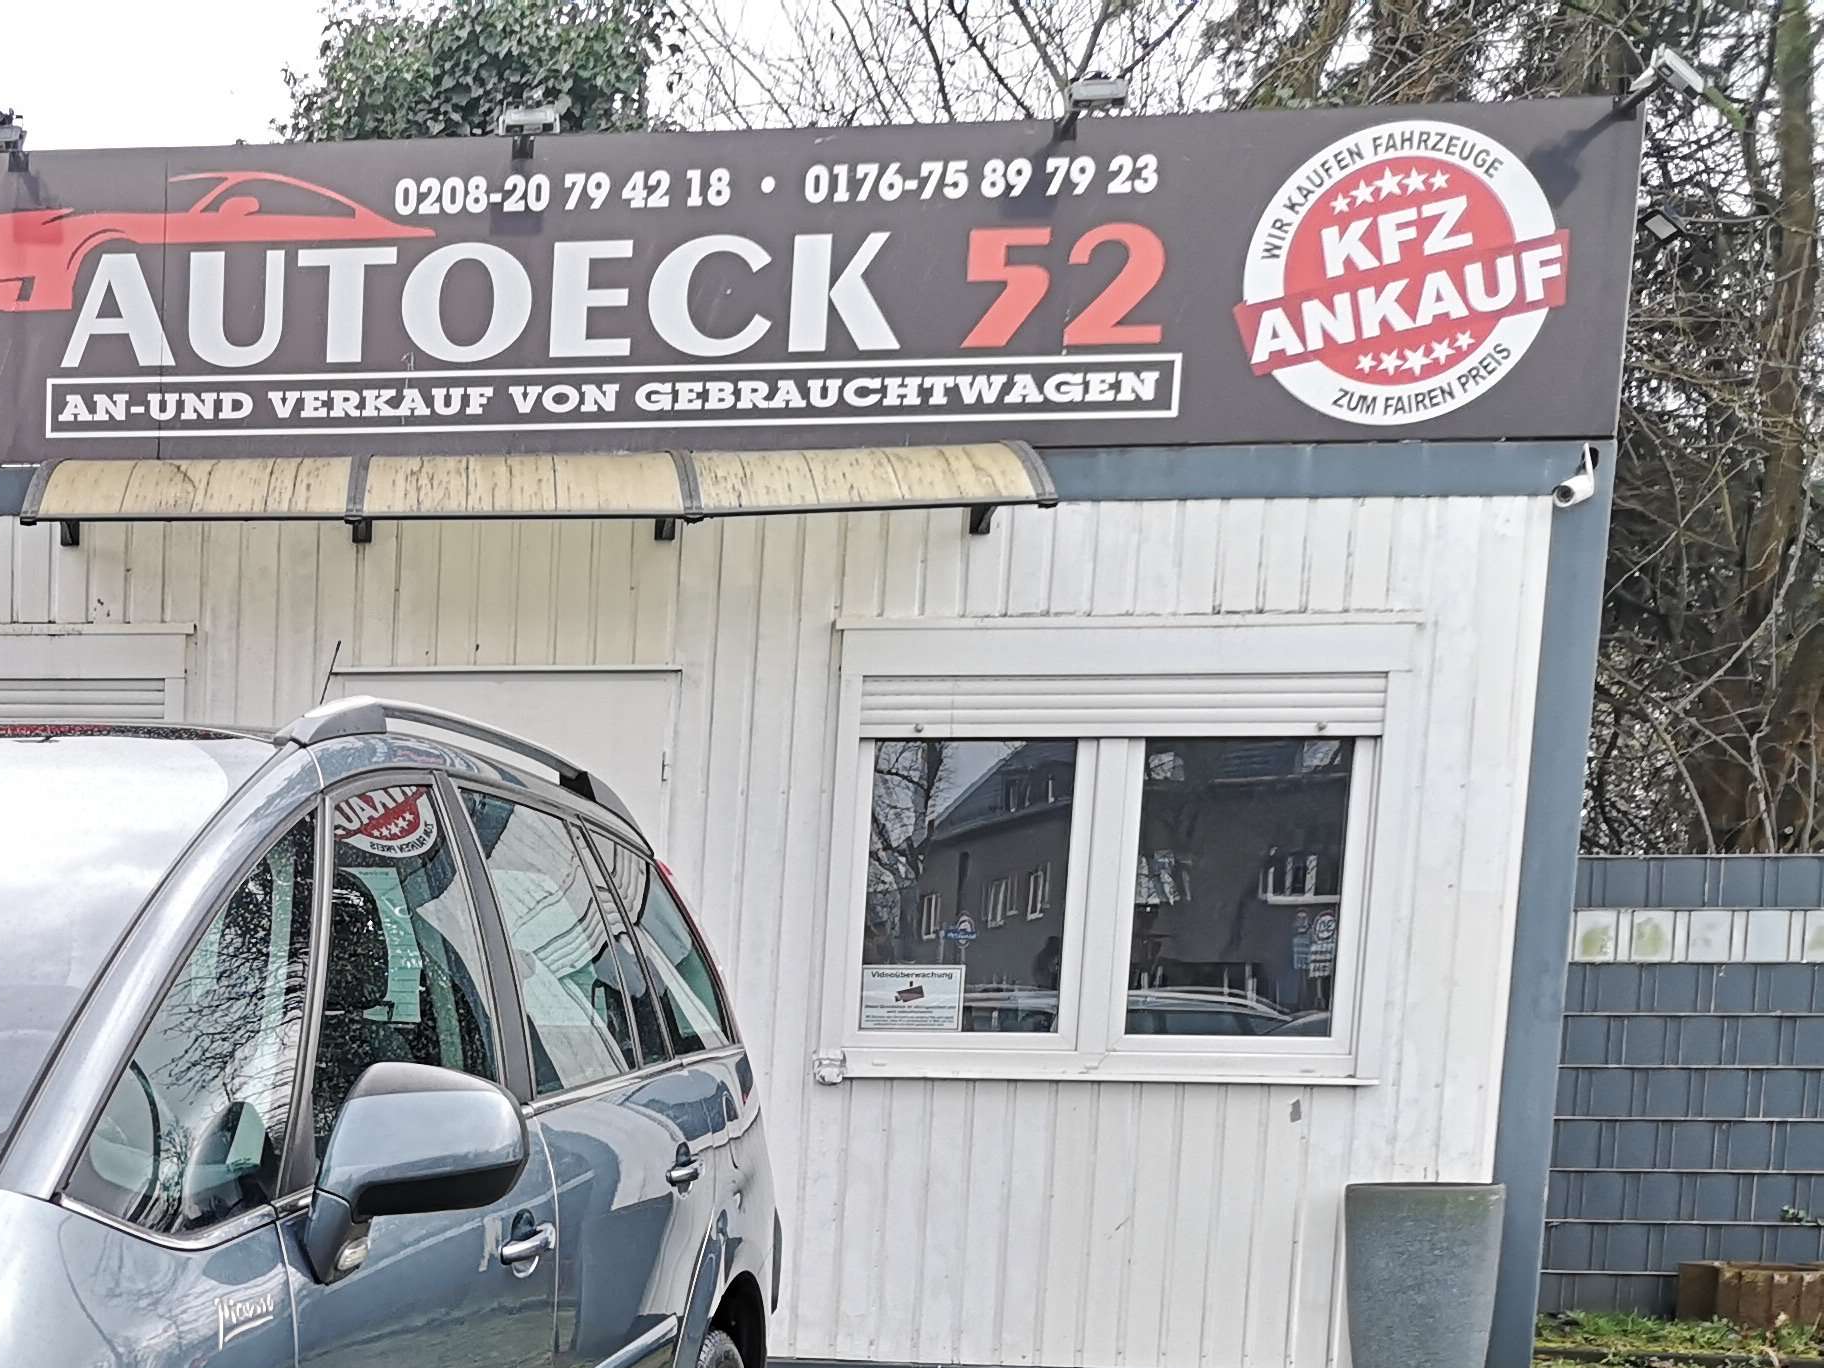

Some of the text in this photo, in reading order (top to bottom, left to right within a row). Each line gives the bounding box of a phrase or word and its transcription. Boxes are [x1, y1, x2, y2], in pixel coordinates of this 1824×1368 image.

[394, 168, 732, 217] 0208-20 79 42 18
[804, 153, 1160, 203] 0176-75 89 79 23
[1261, 130, 1504, 260] WIR KAUFEN FAHRZEUGE
[1320, 194, 1473, 279] KFZ
[61, 222, 1167, 370] AUTOECK 52
[1249, 244, 1563, 366] ANKAUF
[58, 371, 1160, 424] AN-UND VERKAUF VON GEBRAUCHTWAGEN
[1332, 342, 1512, 418] ZUM FAIREN PREIS
